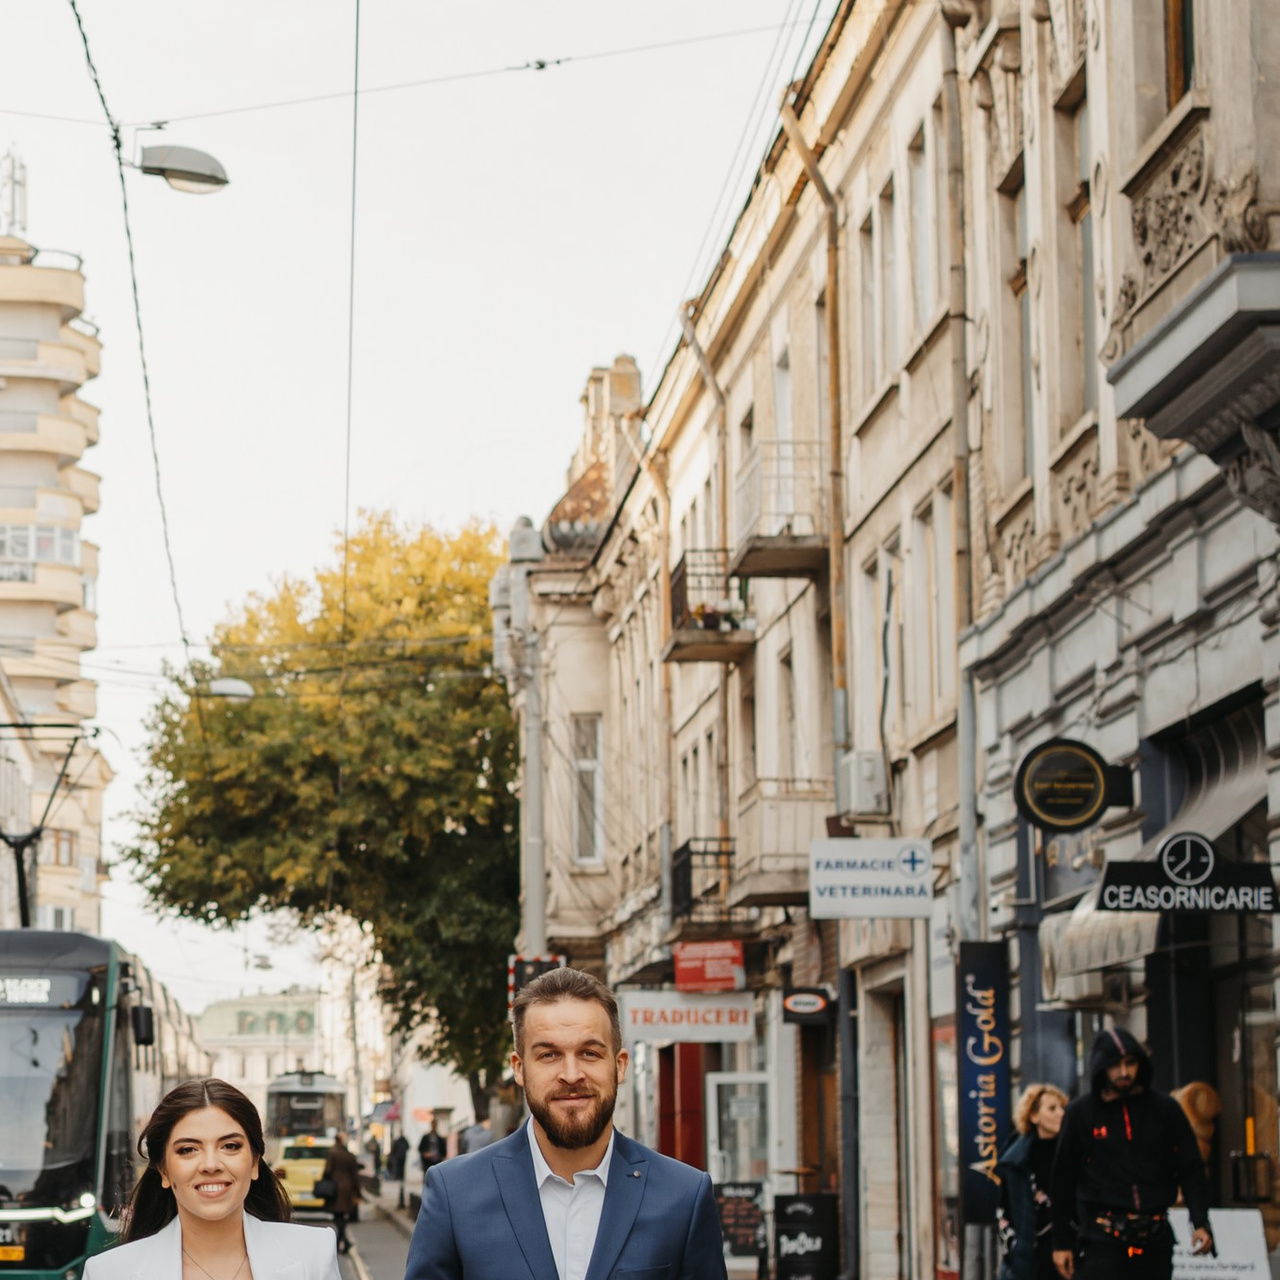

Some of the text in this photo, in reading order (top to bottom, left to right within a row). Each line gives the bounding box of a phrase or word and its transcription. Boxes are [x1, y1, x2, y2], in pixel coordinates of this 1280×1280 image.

[815, 859, 896, 872] FARMACIE
[1103, 884, 1274, 911] CEASORNICARIE
[629, 1006, 750, 1027] TRADUCERI
[965, 972, 1004, 1186] Astoria Gold
